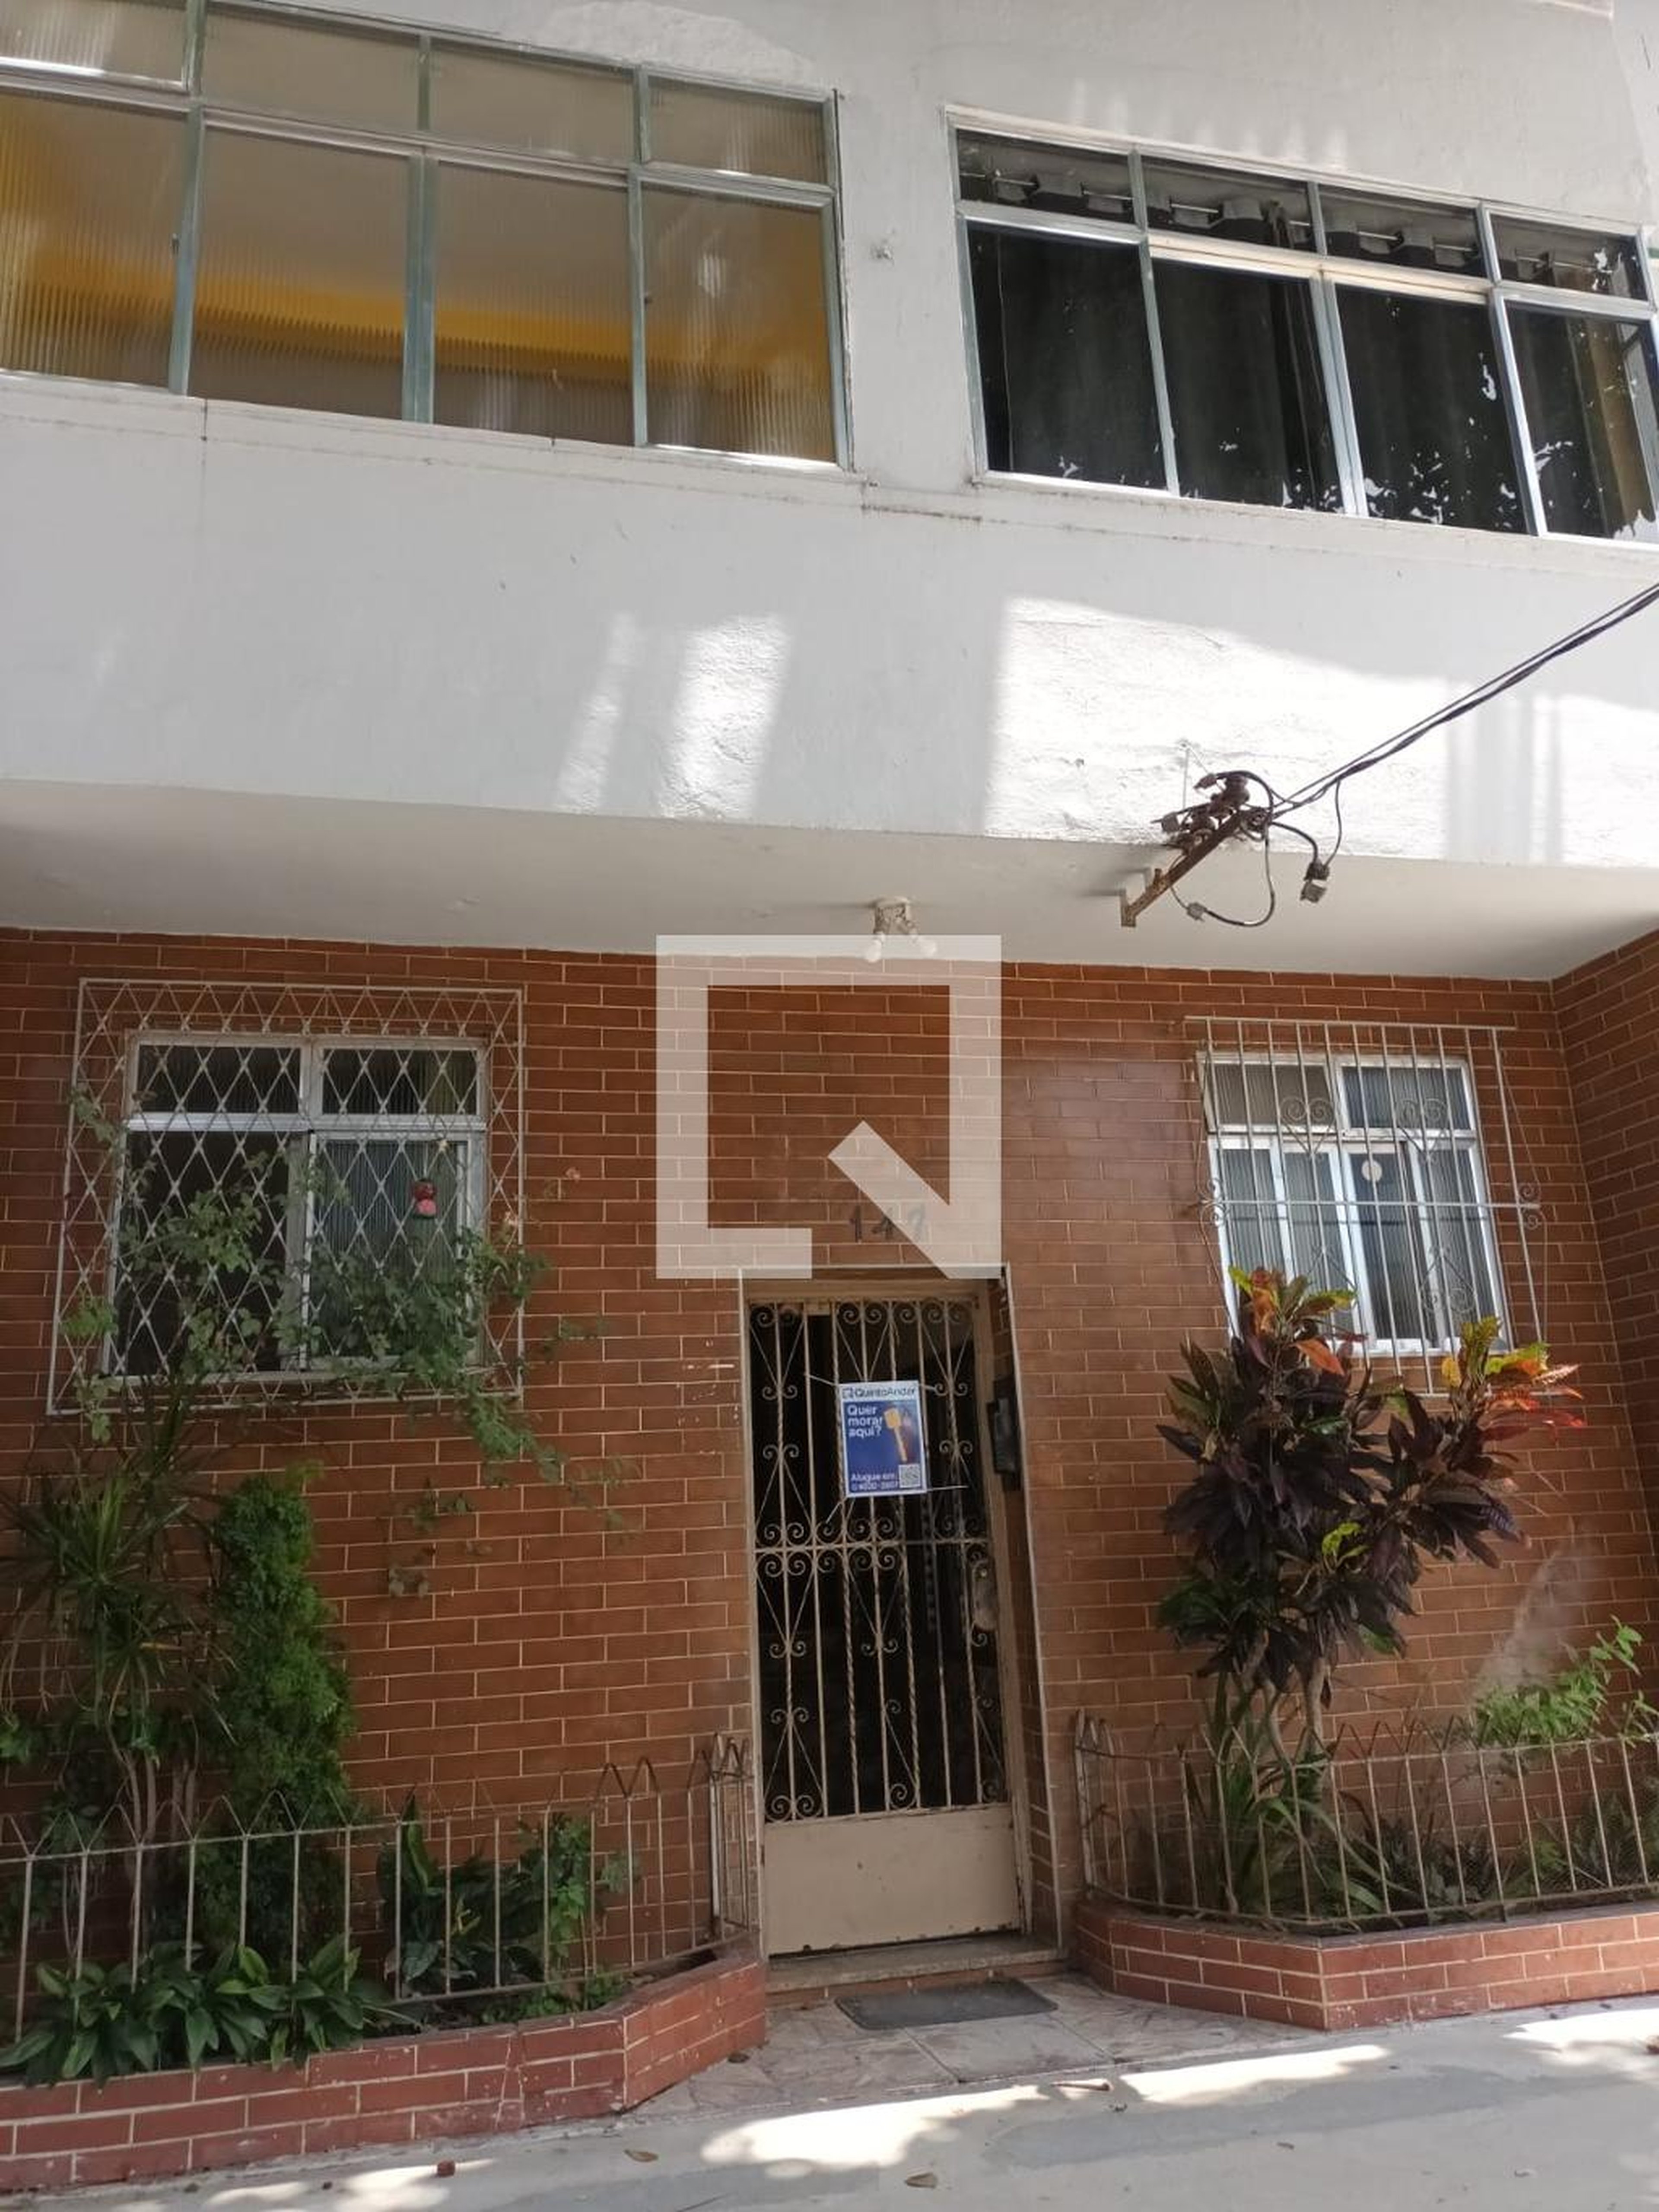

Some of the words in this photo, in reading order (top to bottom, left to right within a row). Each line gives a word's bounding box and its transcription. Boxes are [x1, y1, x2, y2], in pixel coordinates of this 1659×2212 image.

[848, 1405, 877, 1415] Quer
[848, 1416, 882, 1426] morar
[849, 1426, 881, 1439] aqui?
